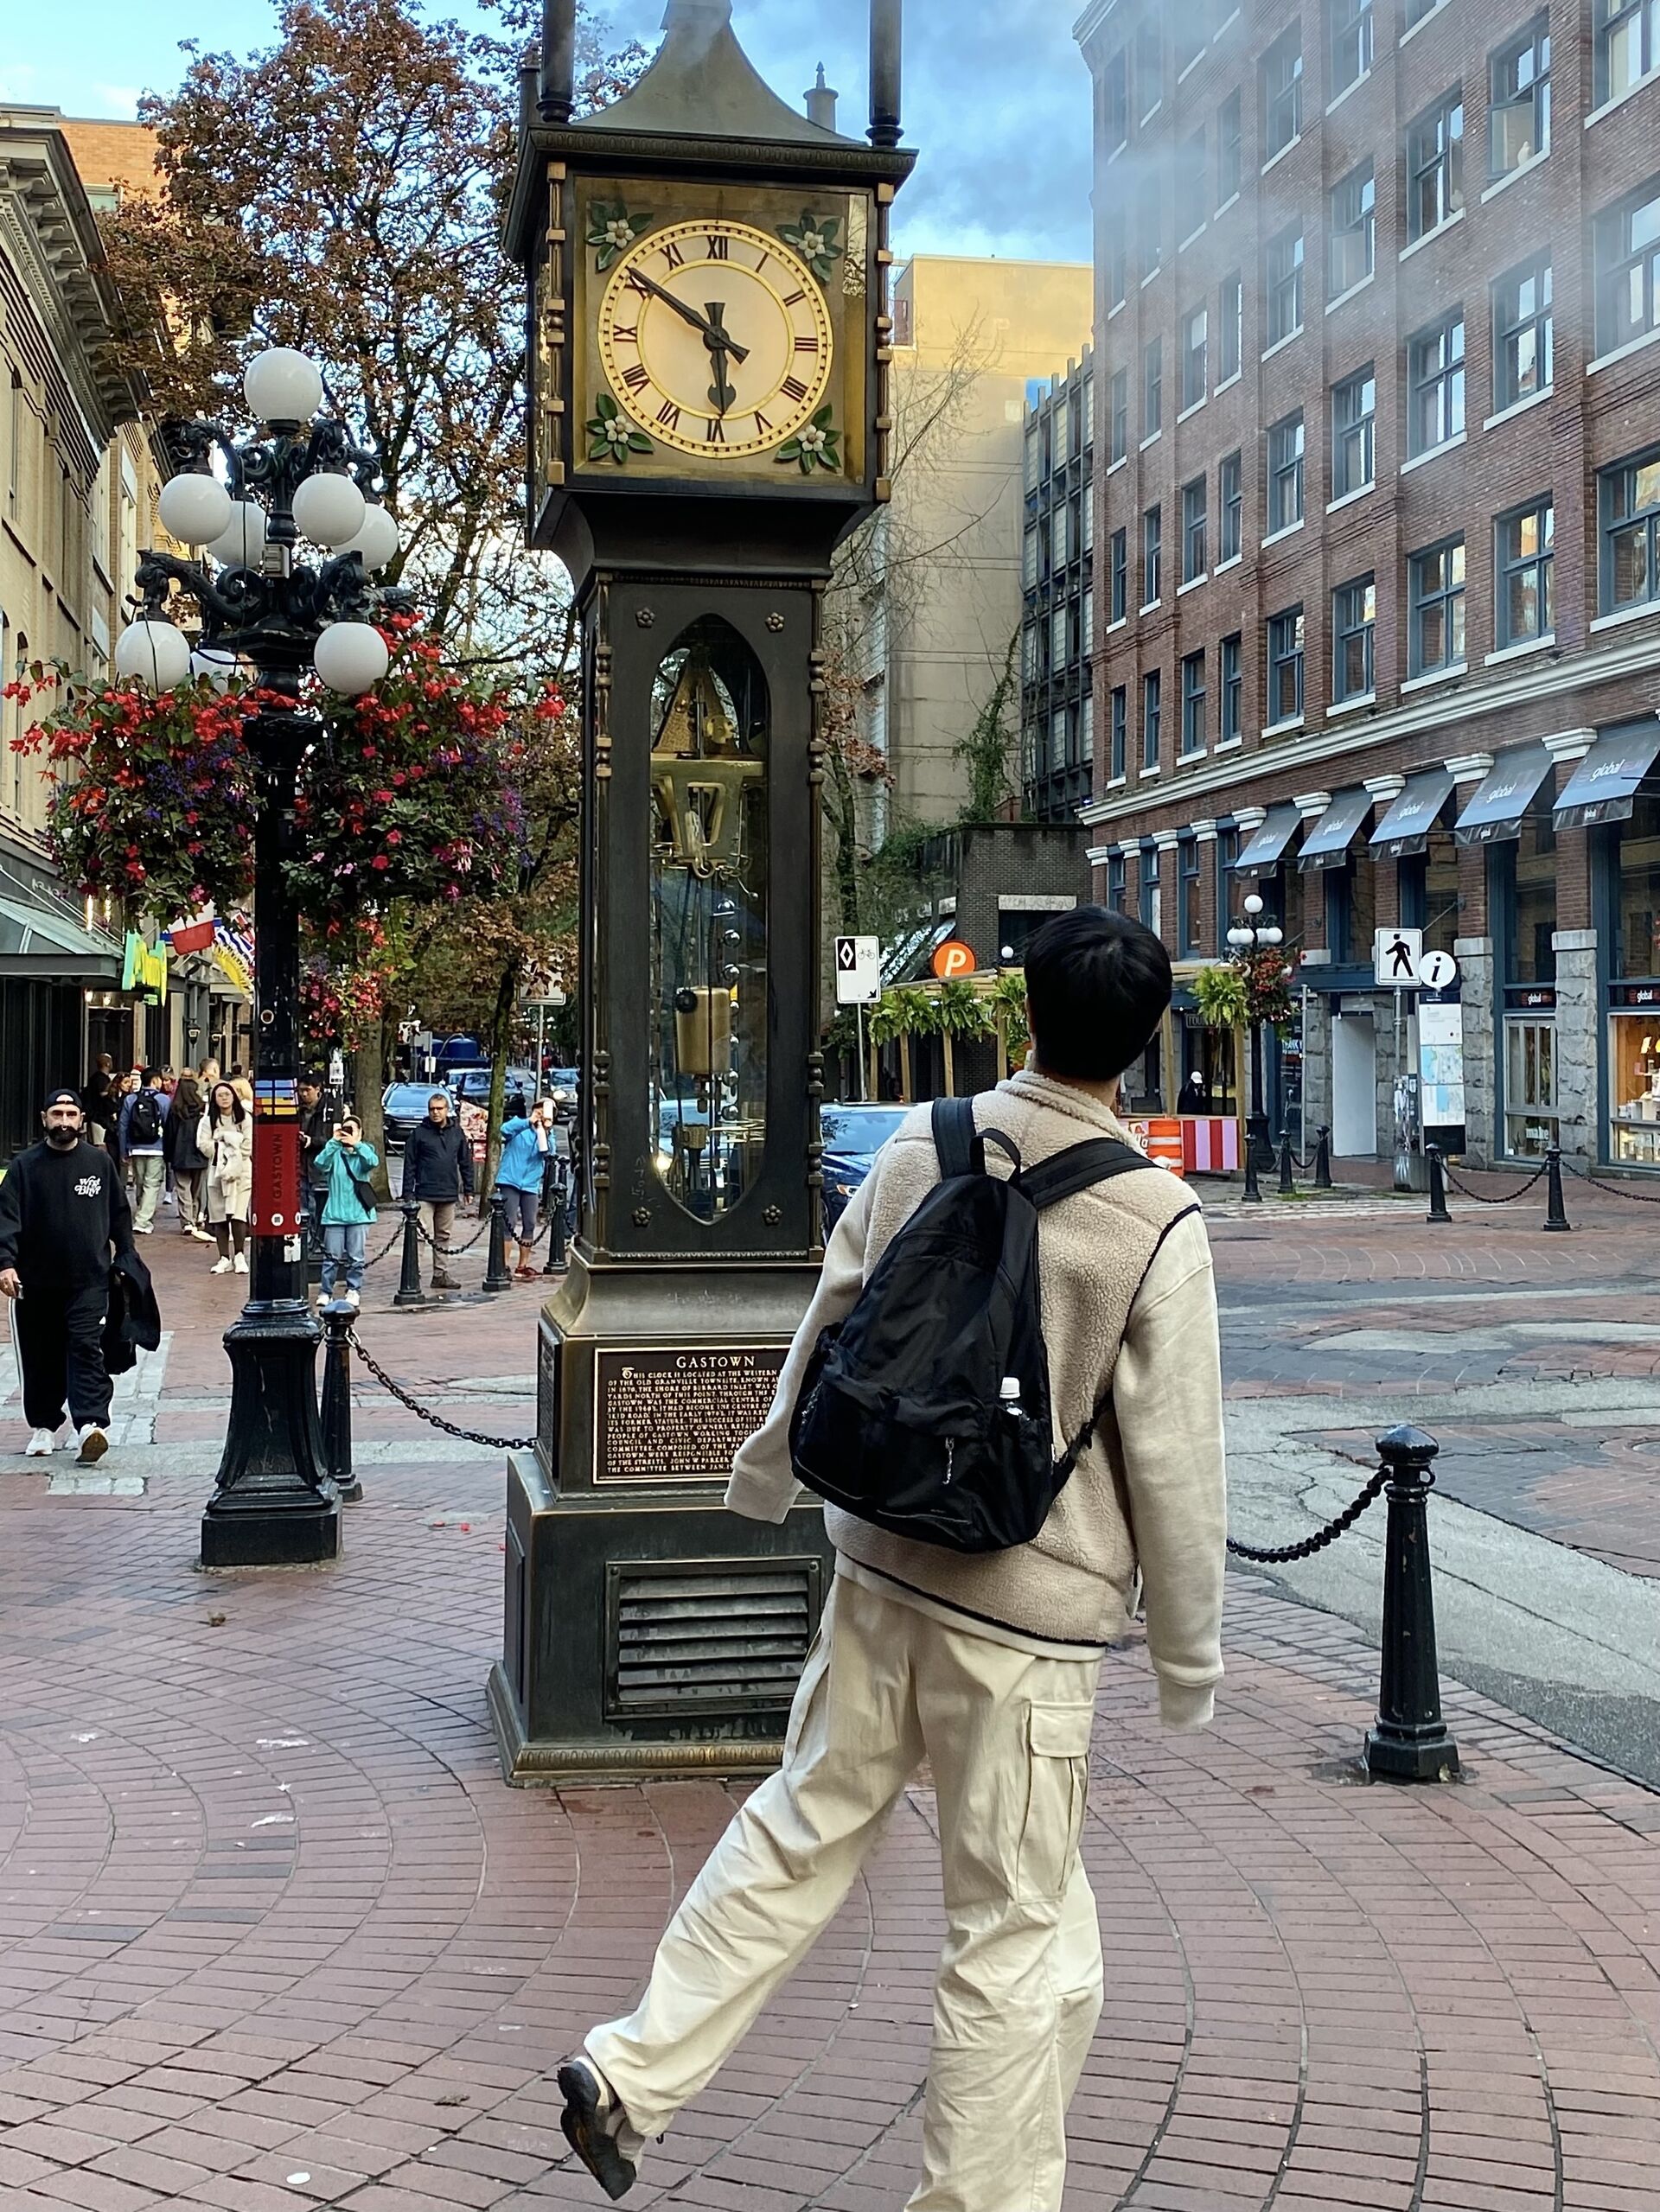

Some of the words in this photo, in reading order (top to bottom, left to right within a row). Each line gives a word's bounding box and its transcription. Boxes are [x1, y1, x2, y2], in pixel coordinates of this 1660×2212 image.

[707, 235, 728, 260] XII
[795, 337, 818, 352] III
[1590, 759, 1626, 782] global
[1487, 782, 1516, 803] global
[1397, 801, 1424, 820] global
[944, 949, 967, 977] P
[1527, 993, 1542, 1005] global
[1636, 990, 1653, 1004] global
[273, 1133, 283, 1198] GASTOWN
[676, 1355, 755, 1368] GASTOWN
[622, 1367, 645, 1379] THIS
